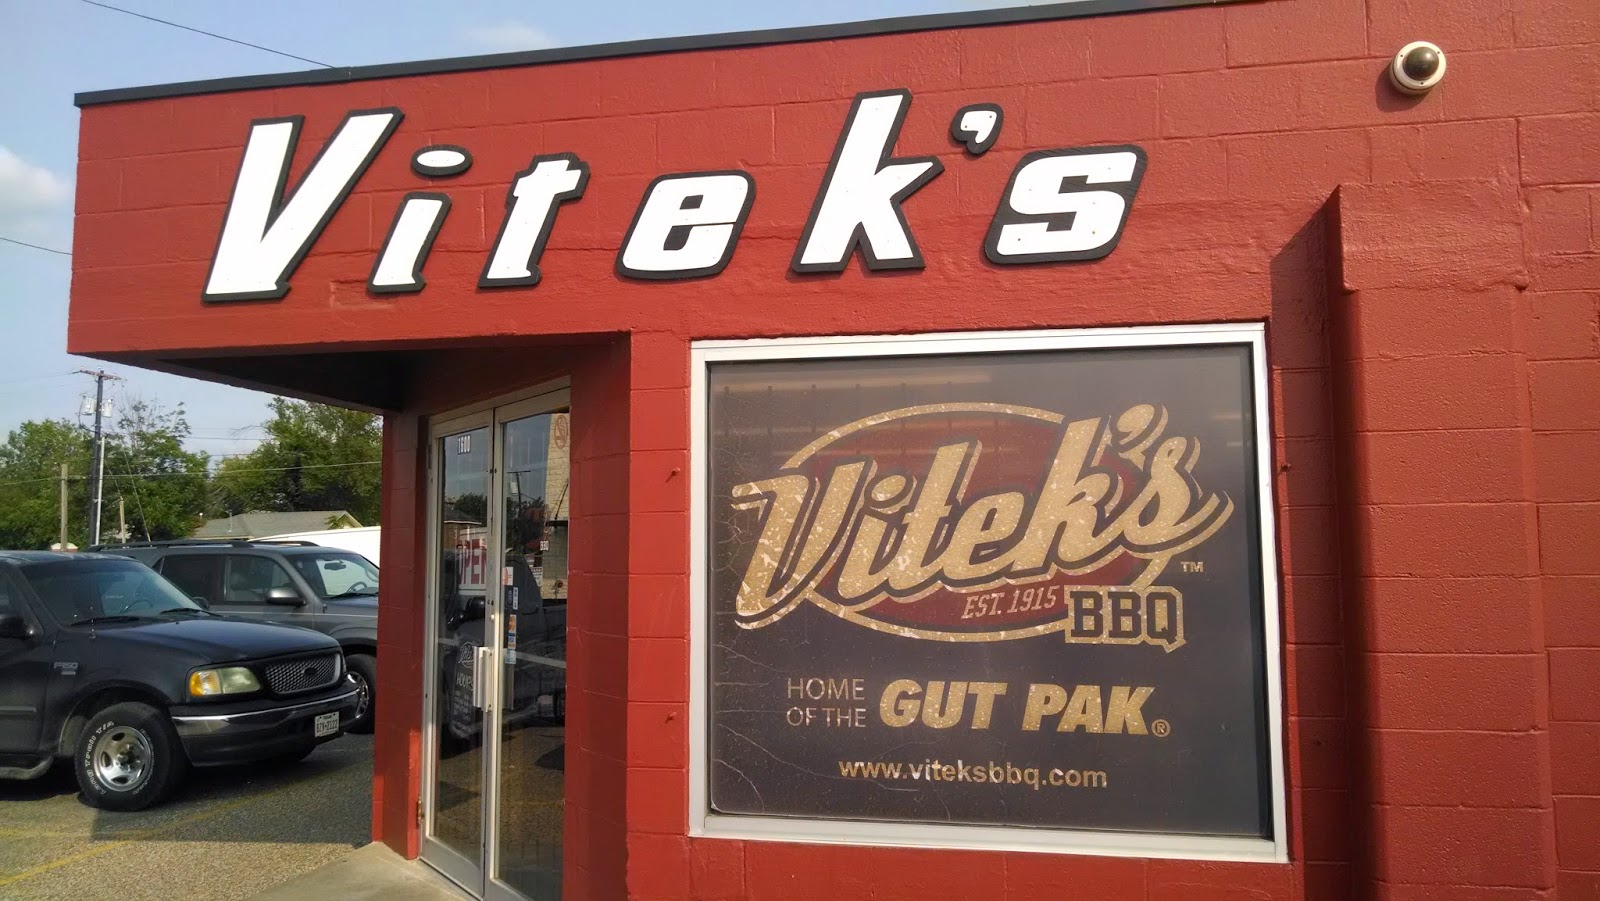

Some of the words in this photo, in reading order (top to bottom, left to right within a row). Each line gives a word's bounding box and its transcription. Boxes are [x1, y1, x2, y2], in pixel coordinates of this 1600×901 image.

[202, 88, 1148, 302] Vitek's
[458, 435, 471, 454] 1600
[731, 403, 1234, 630] Vitek's
[961, 592, 1003, 619] EST.
[1007, 585, 1060, 614] 1915
[1065, 586, 1186, 653] BBQ
[786, 678, 865, 700] HOME
[879, 679, 1008, 730] GUT
[786, 706, 817, 727] OF
[821, 707, 867, 728] THE
[838, 759, 1108, 790] www.viteksbbq.com
